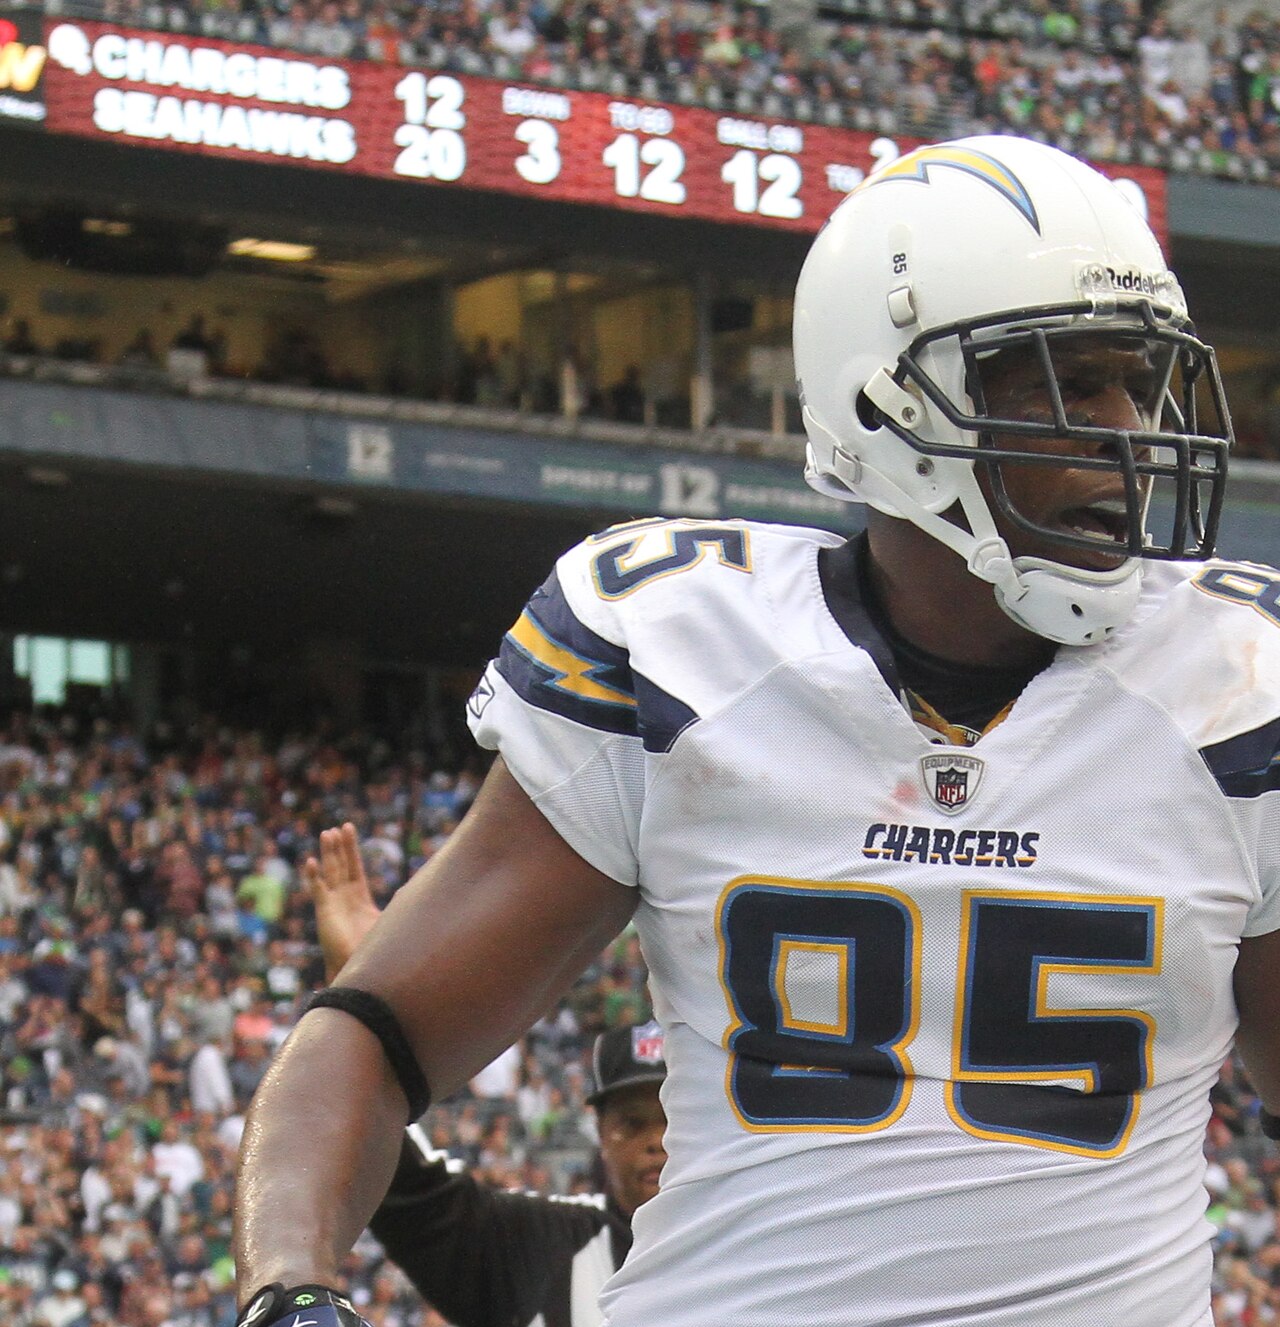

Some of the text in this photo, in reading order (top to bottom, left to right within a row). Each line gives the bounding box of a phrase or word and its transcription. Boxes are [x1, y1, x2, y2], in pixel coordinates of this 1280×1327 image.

[92, 34, 351, 110] CHARGERS
[394, 72, 466, 130] 12
[93, 87, 467, 182] SEAHAWKS 20
[514, 119, 562, 184] 3
[603, 133, 687, 204] 12
[720, 149, 804, 218] 12
[892, 252, 907, 274] 85
[658, 463, 720, 514] 12
[924, 756, 982, 772] EQUIPMENT
[937, 783, 967, 804] NFL
[861, 822, 1041, 868] CHARGERS
[713, 873, 1166, 1160] 85
